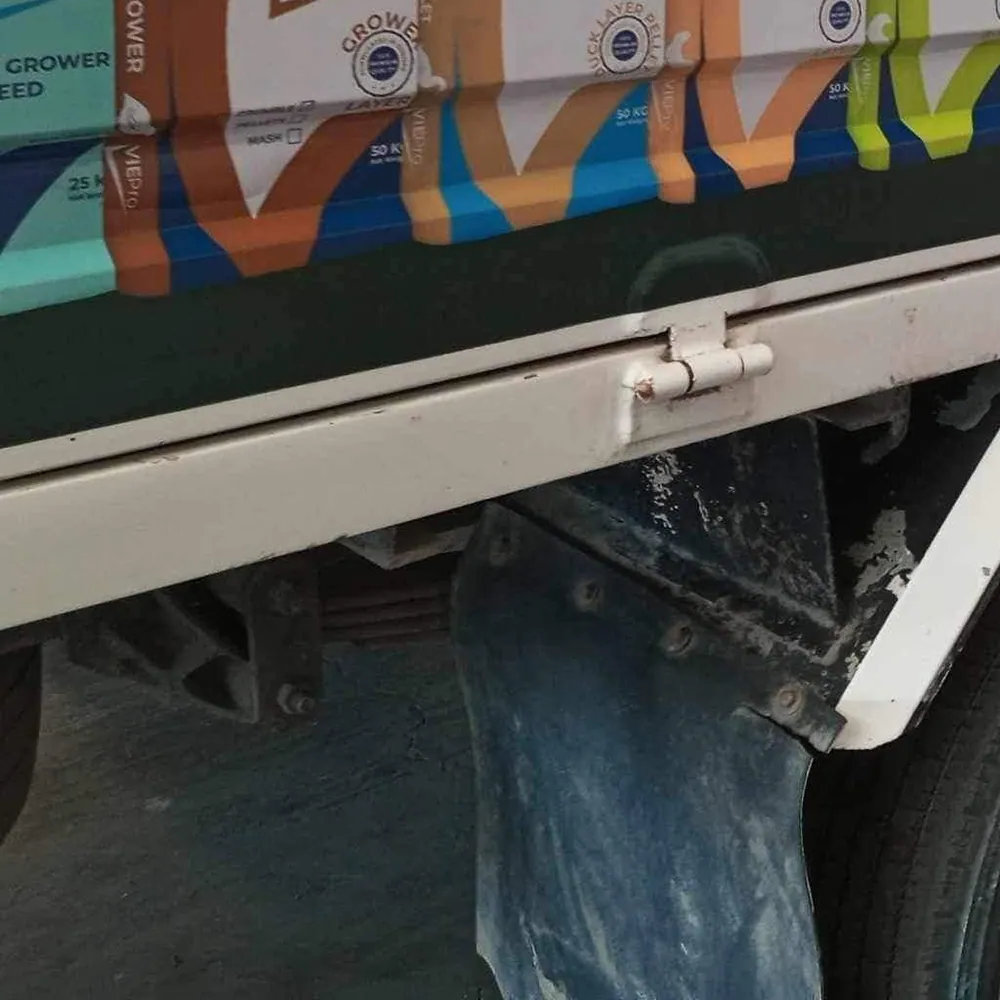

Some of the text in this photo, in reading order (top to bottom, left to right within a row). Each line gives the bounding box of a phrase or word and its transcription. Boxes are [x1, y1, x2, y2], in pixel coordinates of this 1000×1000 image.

[341, 10, 420, 54] GROWE
[4, 50, 111, 76] GROWER
[370, 144, 388, 158] 50
[67, 175, 90, 191] 25
[123, 145, 145, 210] VIEPro
